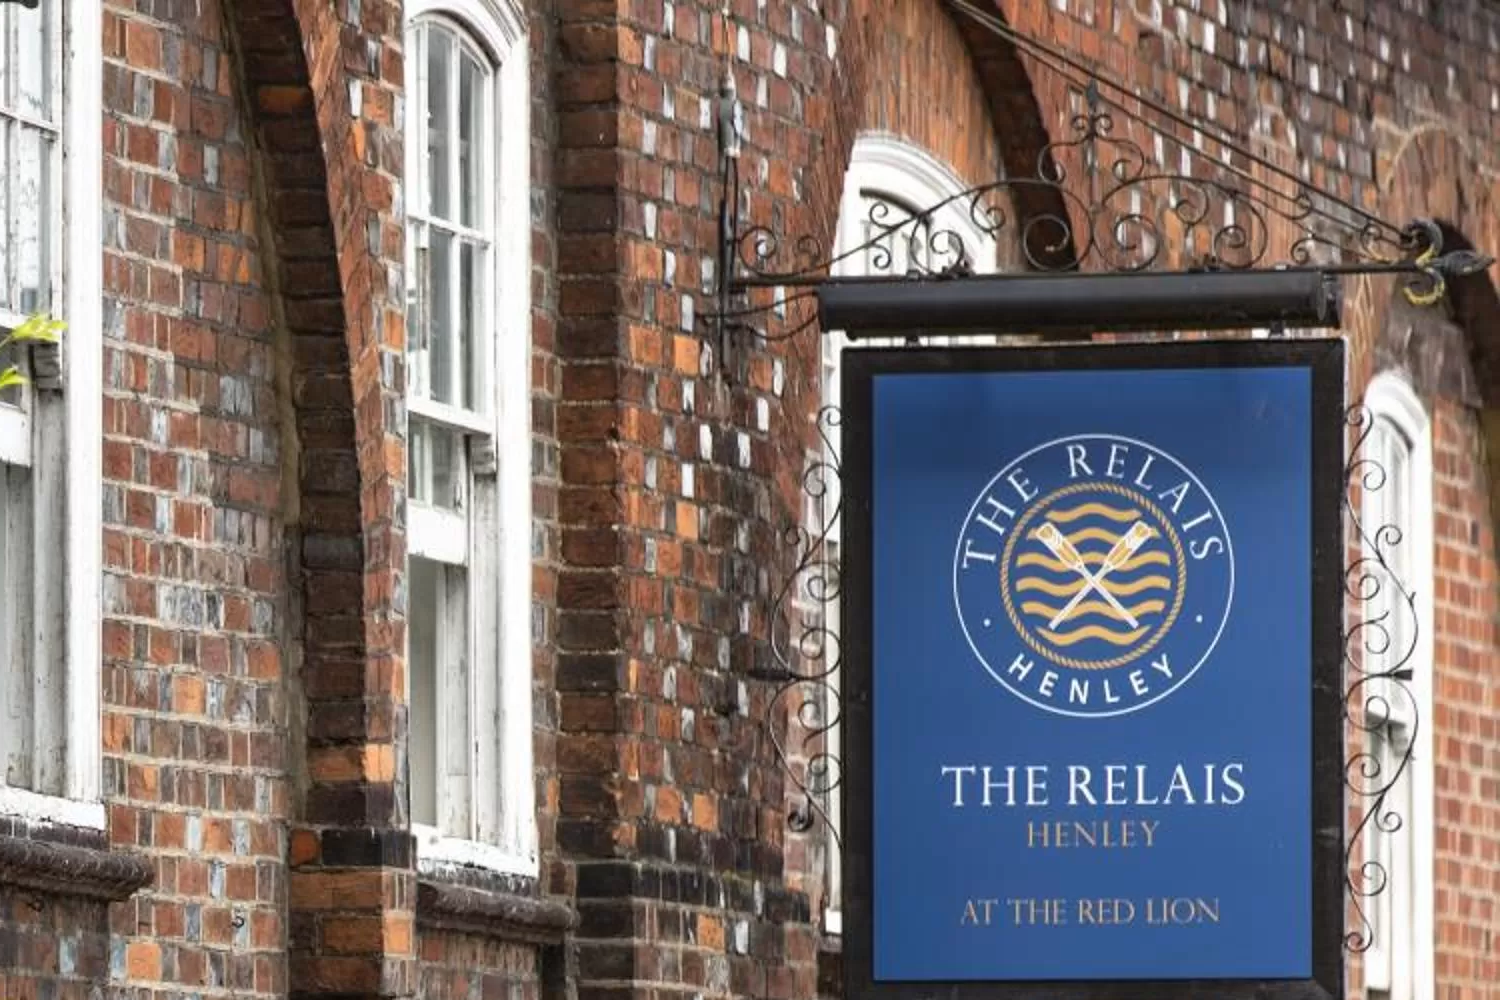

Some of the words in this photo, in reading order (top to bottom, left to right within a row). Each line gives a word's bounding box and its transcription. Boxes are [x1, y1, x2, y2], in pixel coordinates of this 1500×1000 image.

[962, 467, 1040, 569] THE
[1066, 443, 1224, 561] RELAIS
[1007, 653, 1174, 704] HENLEY
[941, 764, 1049, 806] THE
[1066, 763, 1246, 806] RELAIS
[1027, 820, 1161, 848] HENLEY
[960, 898, 998, 925] AT
[1007, 898, 1067, 925] THE
[1077, 898, 1135, 924] RED
[1146, 898, 1221, 924] LION
